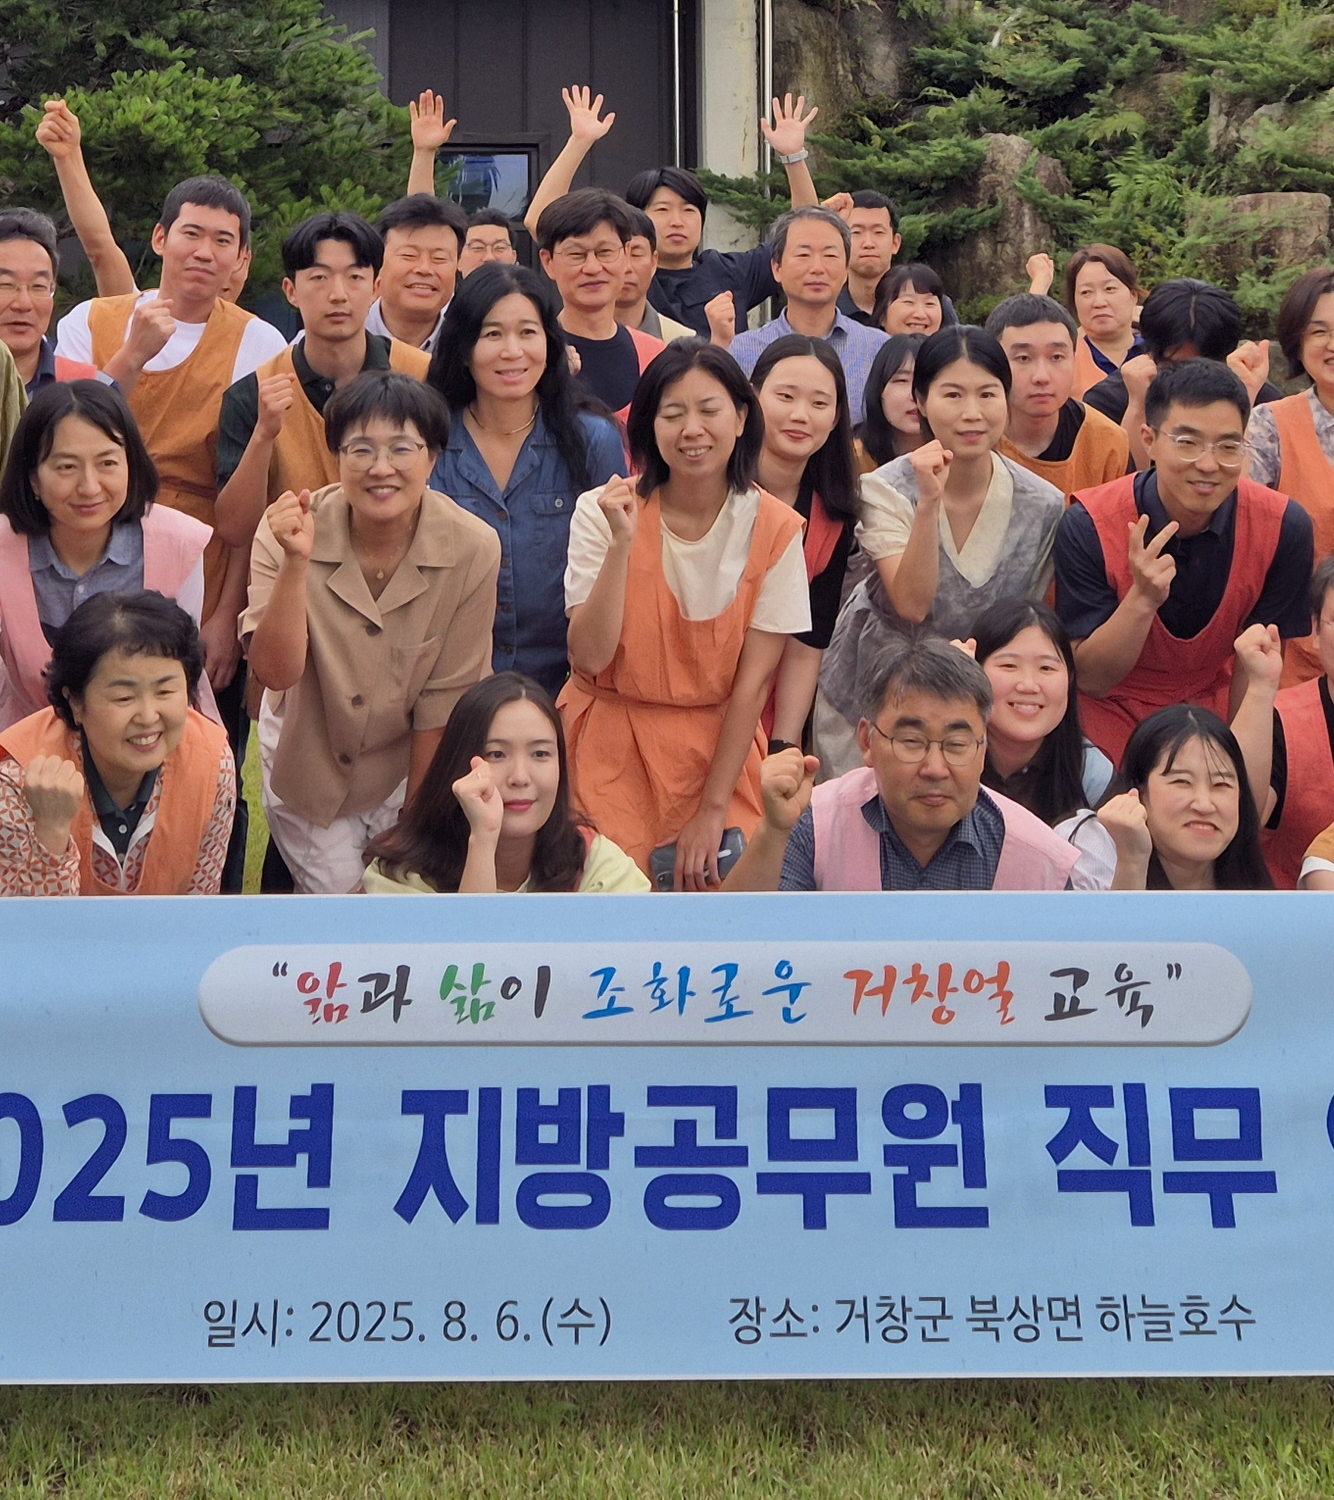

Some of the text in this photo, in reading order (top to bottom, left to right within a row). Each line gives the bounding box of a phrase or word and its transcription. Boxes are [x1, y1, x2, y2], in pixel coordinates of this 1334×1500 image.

[439, 962, 552, 1026] 삶이
[581, 959, 814, 1026] 조화로운
[843, 960, 1017, 1027] 거창얼
[393, 1083, 991, 1232] 지방공무원
[1044, 1083, 1279, 1230] 직무
[204, 1299, 295, 1349] 일시:
[309, 1301, 427, 1344] 2025.
[443, 1301, 479, 1344] 8.
[729, 1294, 1258, 1346] 장소: 거창군 북상면 하늘호수
